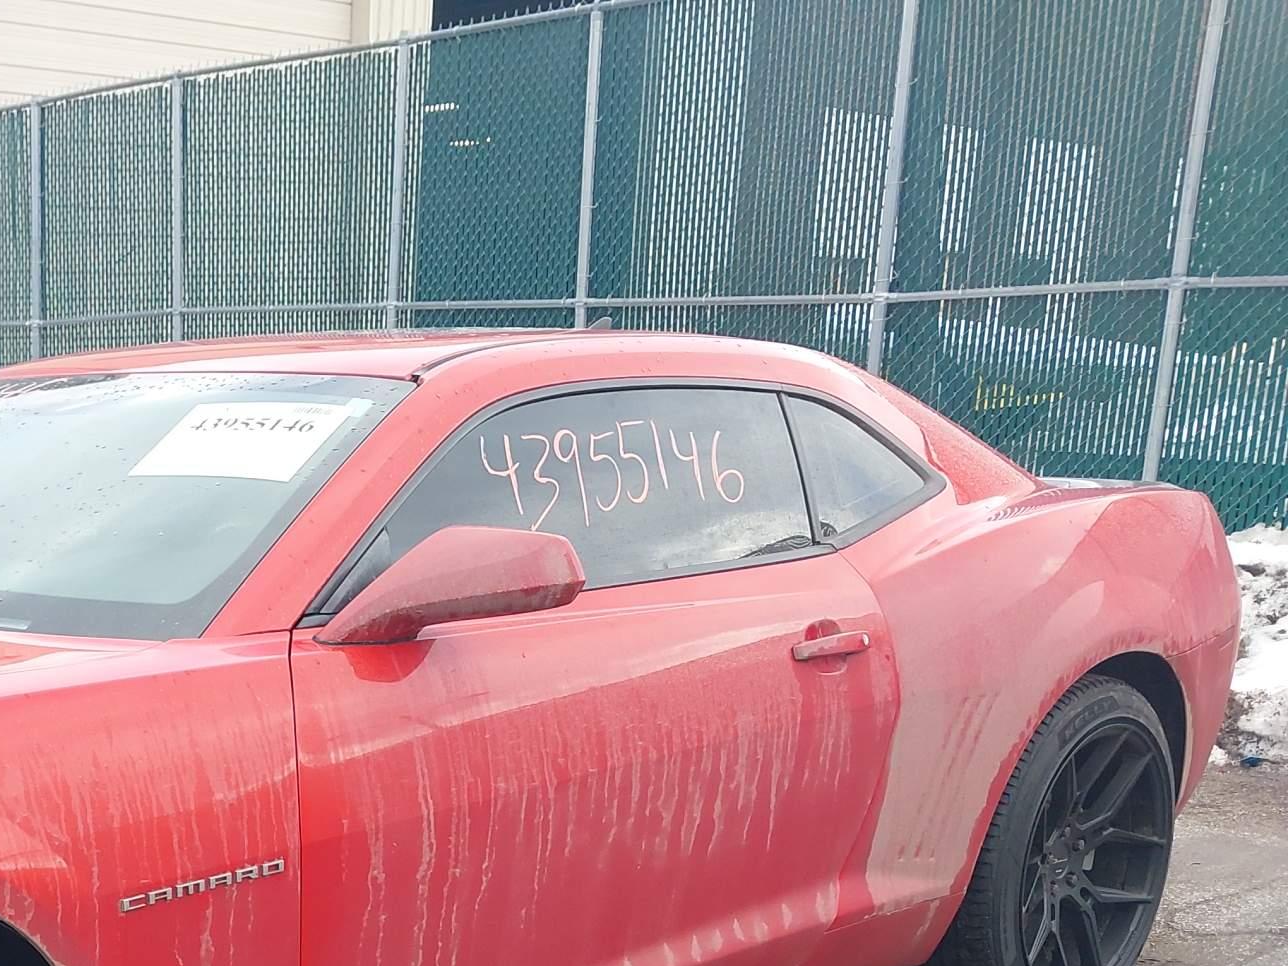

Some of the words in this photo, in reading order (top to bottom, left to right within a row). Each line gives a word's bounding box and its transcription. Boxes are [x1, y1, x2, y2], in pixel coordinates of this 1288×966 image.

[190, 417, 316, 434] 43955146
[479, 419, 744, 531] 43955146
[120, 859, 285, 913] CAMARO
